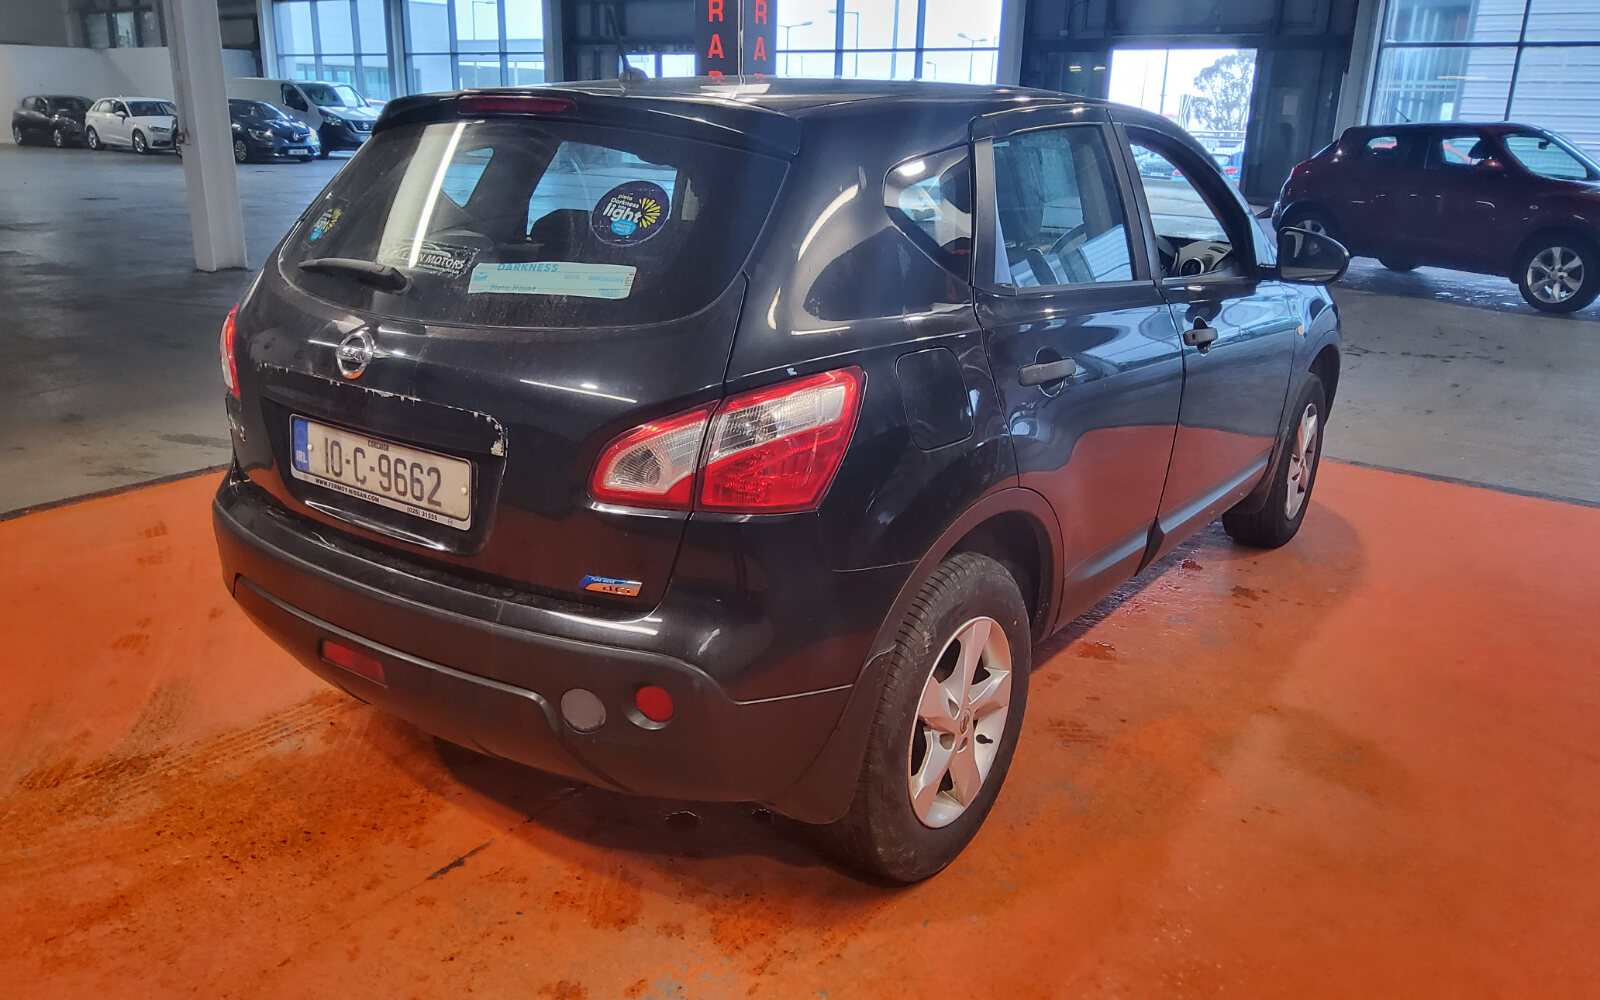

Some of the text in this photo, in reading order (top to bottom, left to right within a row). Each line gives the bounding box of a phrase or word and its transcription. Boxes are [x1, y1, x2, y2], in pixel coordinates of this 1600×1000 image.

[602, 202, 642, 223] light
[425, 254, 466, 269] MOTORS
[497, 262, 559, 273] DARKNESS
[295, 450, 308, 464] IRL
[324, 436, 442, 508] 10-C-9662
